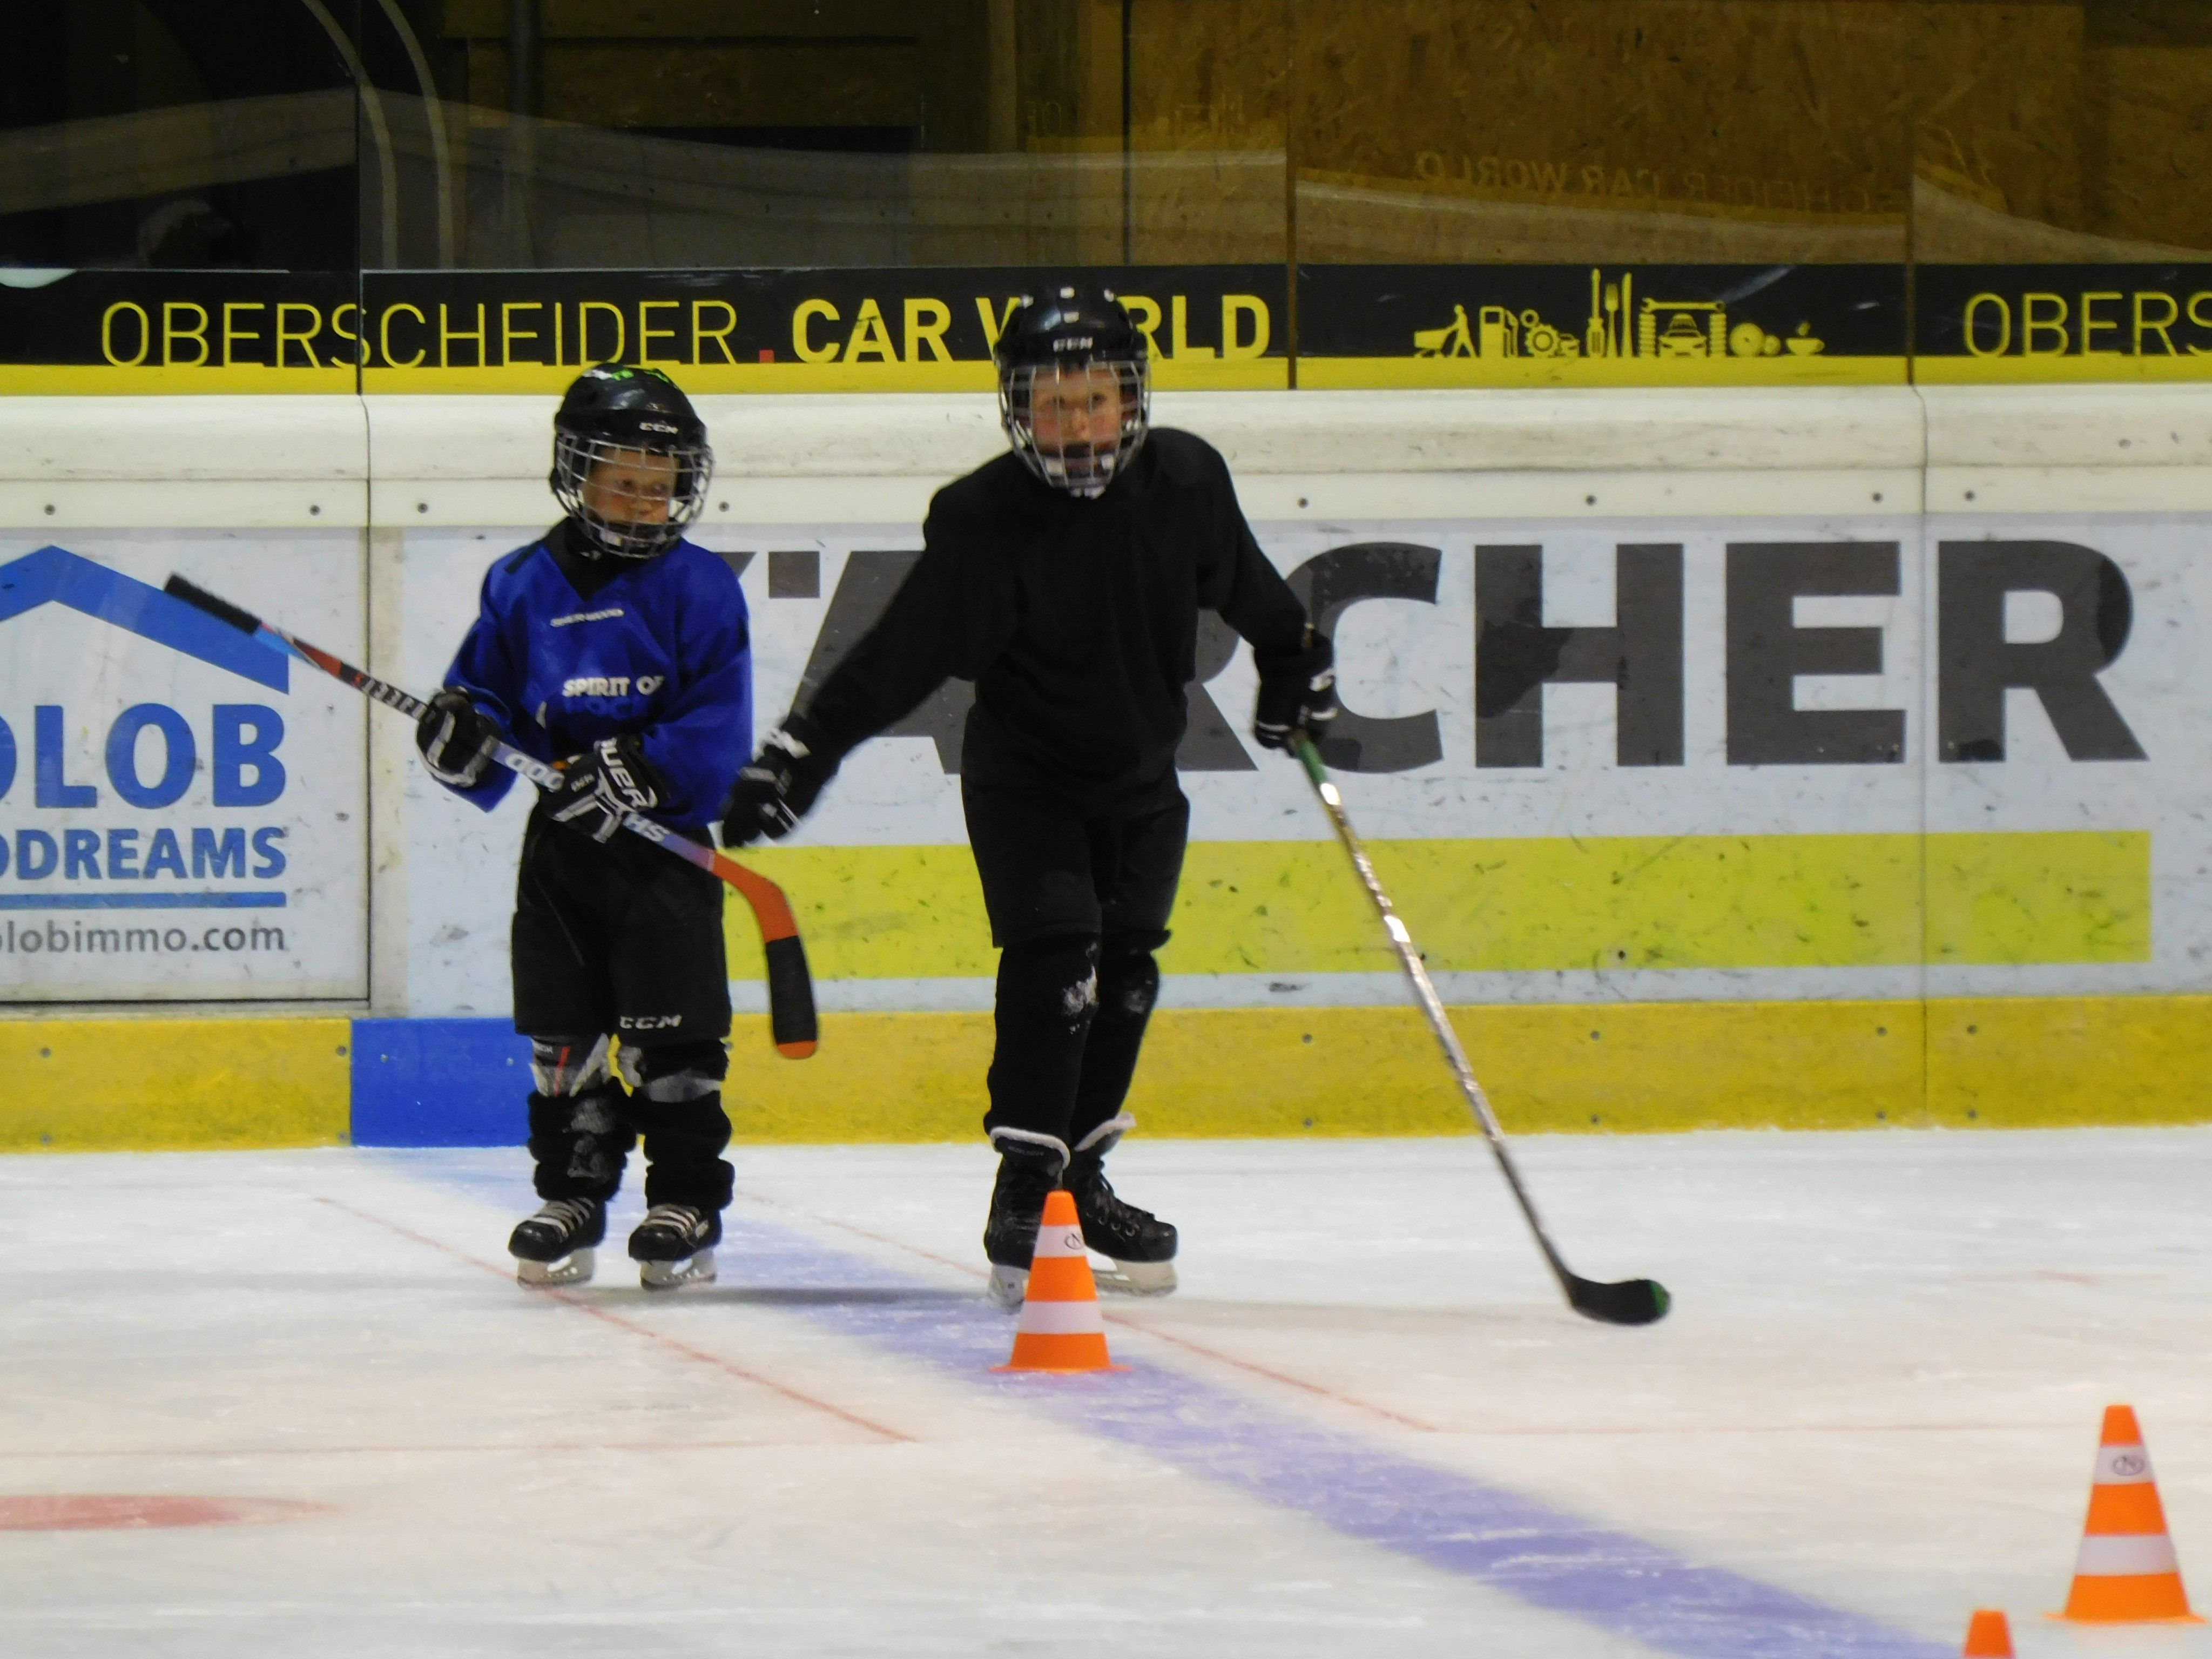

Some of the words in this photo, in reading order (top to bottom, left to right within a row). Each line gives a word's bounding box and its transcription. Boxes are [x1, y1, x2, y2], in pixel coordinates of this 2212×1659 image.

[792, 298, 956, 364] CAR
[975, 294, 1271, 362] RLD
[562, 676, 631, 697] SPIRIT
[713, 539, 2149, 774] CHER
[0, 703, 286, 809] LOB
[595, 737, 649, 808] UER
[0, 827, 287, 880] DREAMS
[0, 920, 285, 953] lobimmo.com
[619, 1014, 683, 1029] CCM
